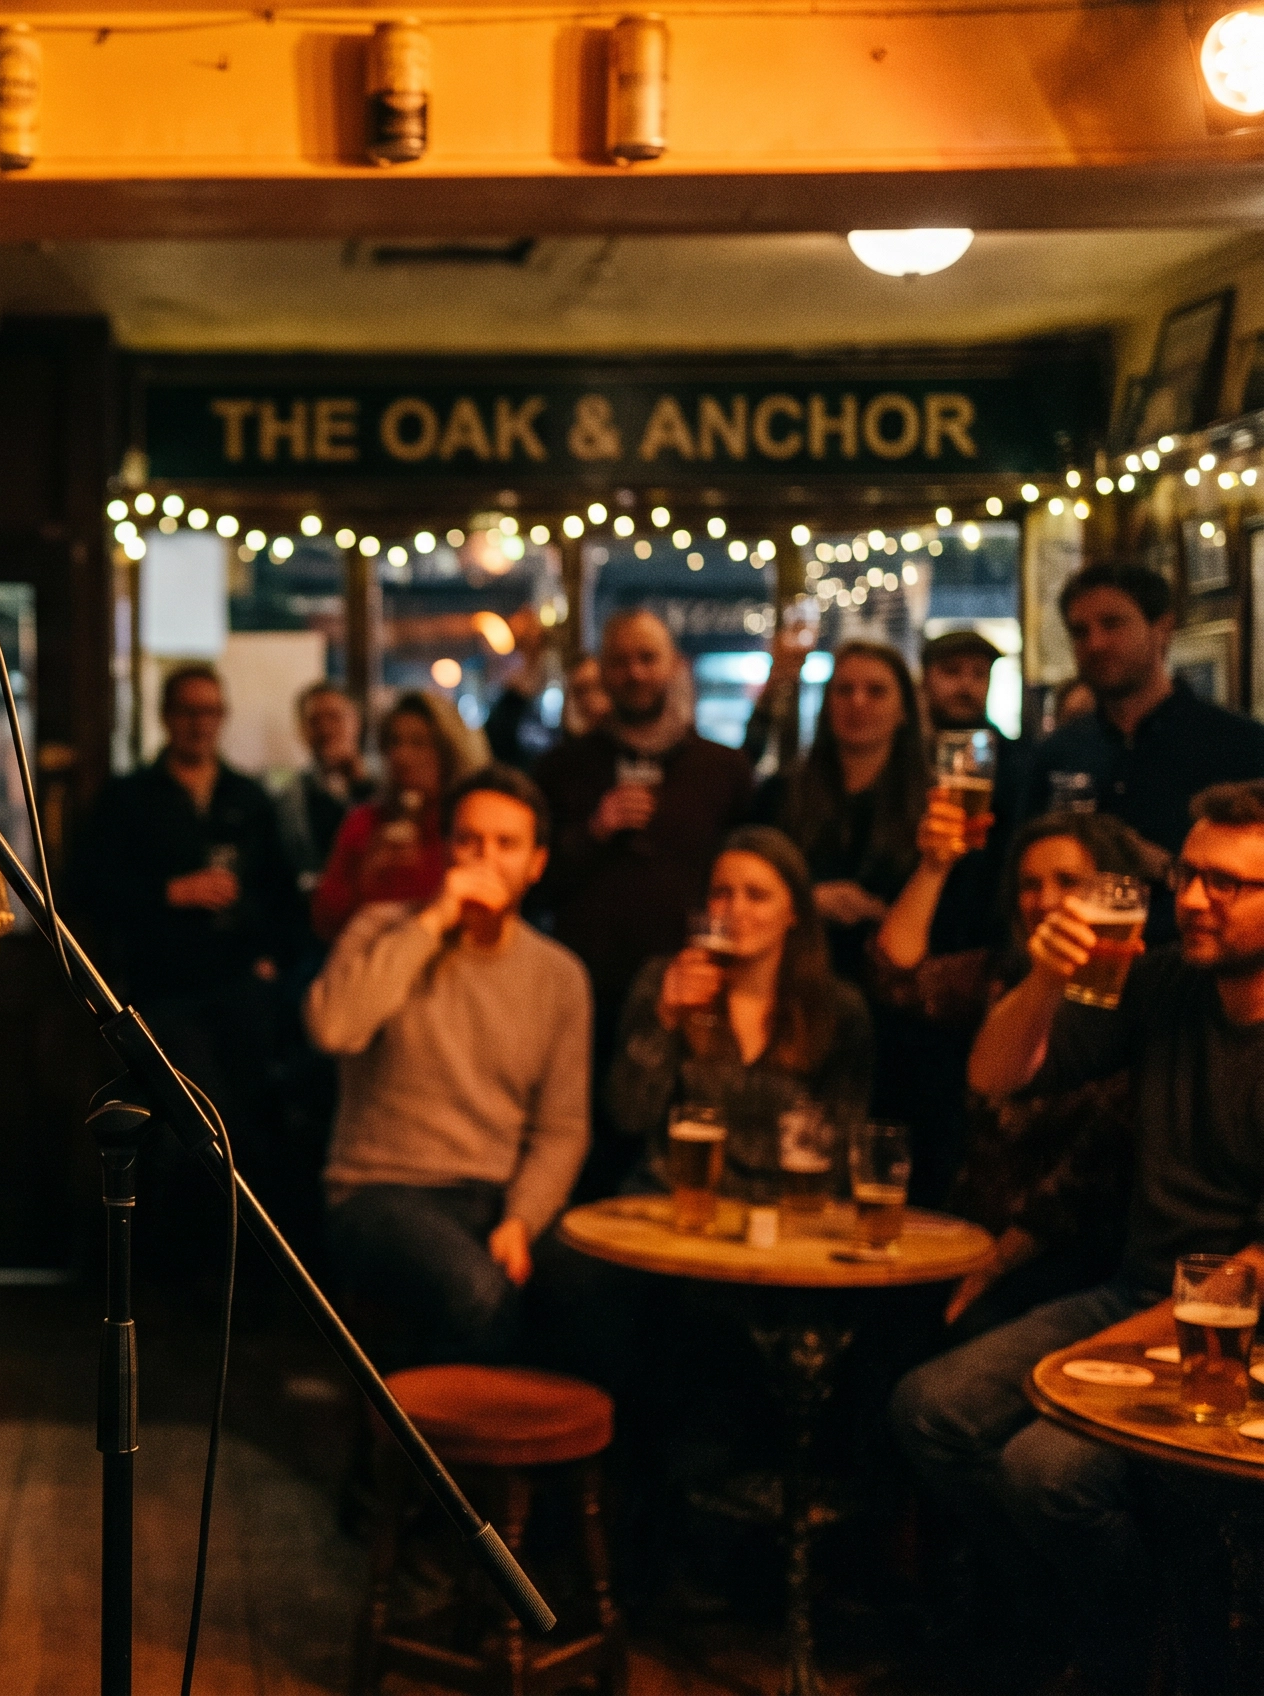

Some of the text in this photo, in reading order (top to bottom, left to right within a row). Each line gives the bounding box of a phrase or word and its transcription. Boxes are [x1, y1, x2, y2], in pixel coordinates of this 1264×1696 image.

[212, 393, 977, 460] THE OAK & ANCHOR
